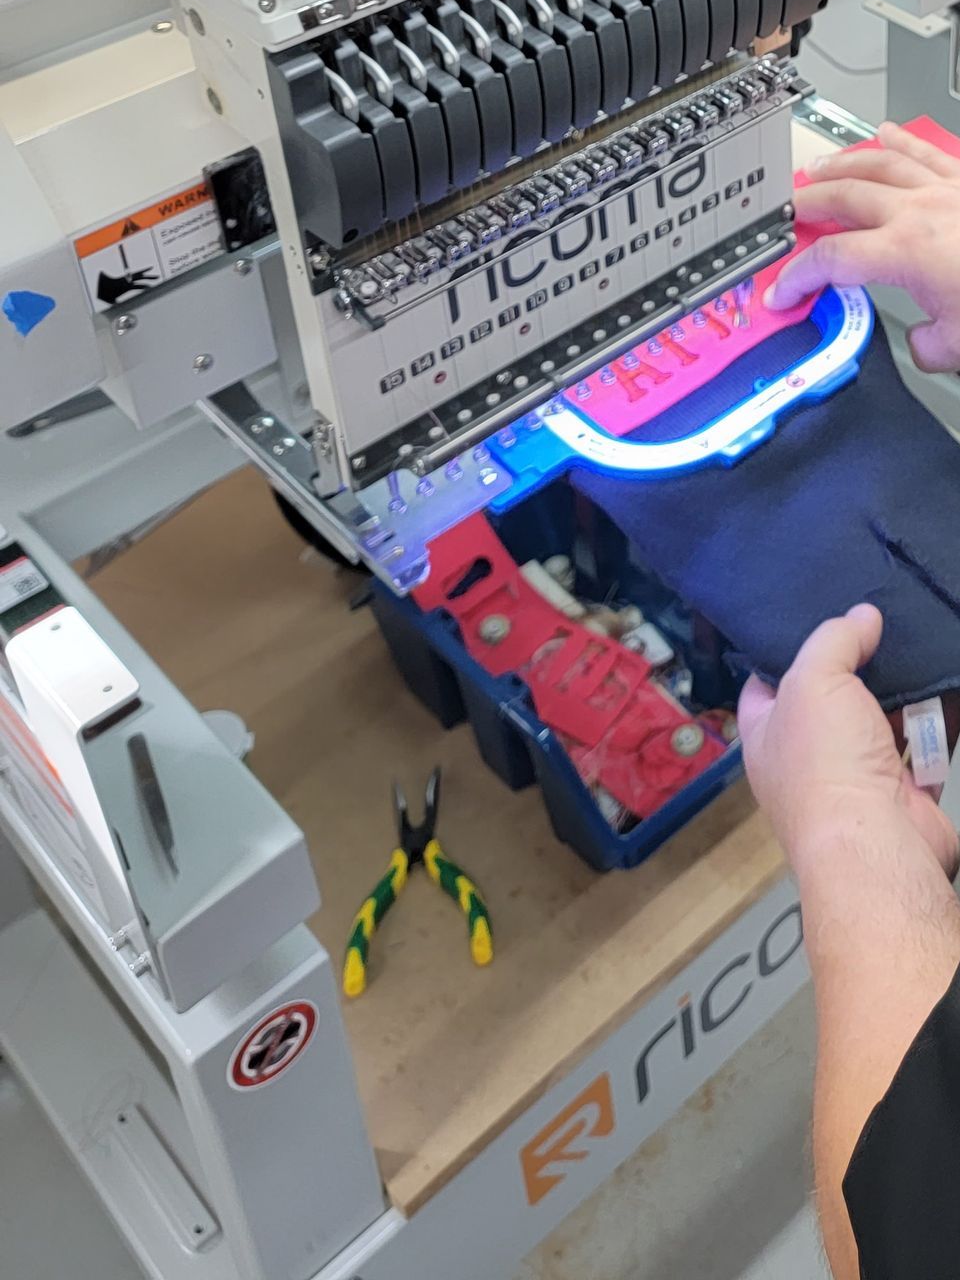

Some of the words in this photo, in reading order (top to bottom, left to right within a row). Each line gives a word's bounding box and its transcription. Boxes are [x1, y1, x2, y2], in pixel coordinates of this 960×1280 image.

[158, 185, 209, 216] WARN
[447, 141, 706, 324] ricoma
[634, 900, 804, 1104] rico
